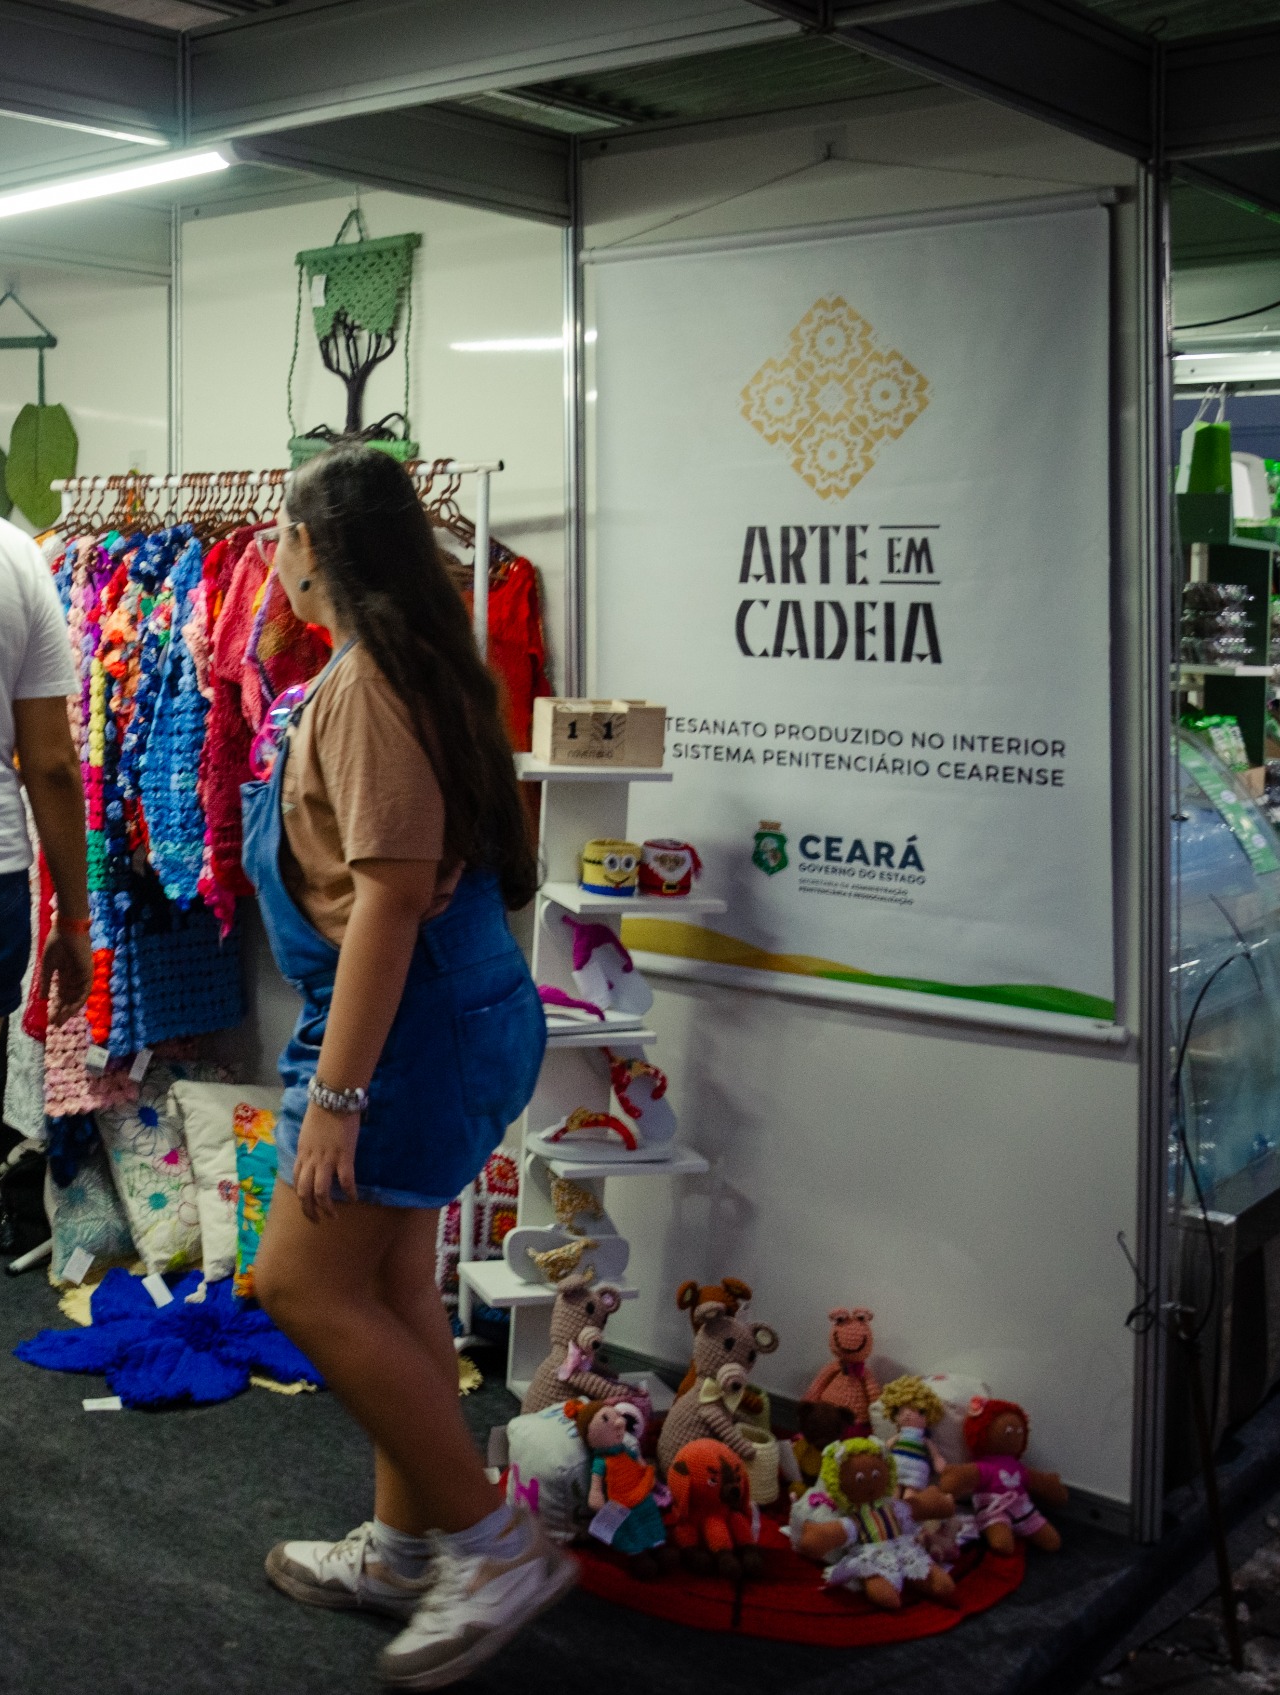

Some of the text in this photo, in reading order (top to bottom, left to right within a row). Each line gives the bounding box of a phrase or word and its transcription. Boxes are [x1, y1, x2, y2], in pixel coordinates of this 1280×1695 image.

[739, 525, 934, 585] ARTE EM
[735, 599, 942, 664] CADEIA
[664, 716, 1066, 758] TESANATO PRODUZIDO NO INTERIOR
[672, 742, 1065, 787] SISTEMA PENITENCIÁRIO CEARENSE
[799, 834, 925, 872] CEARÁ
[799, 862, 927, 885] GOVERNO DO ESTADO
